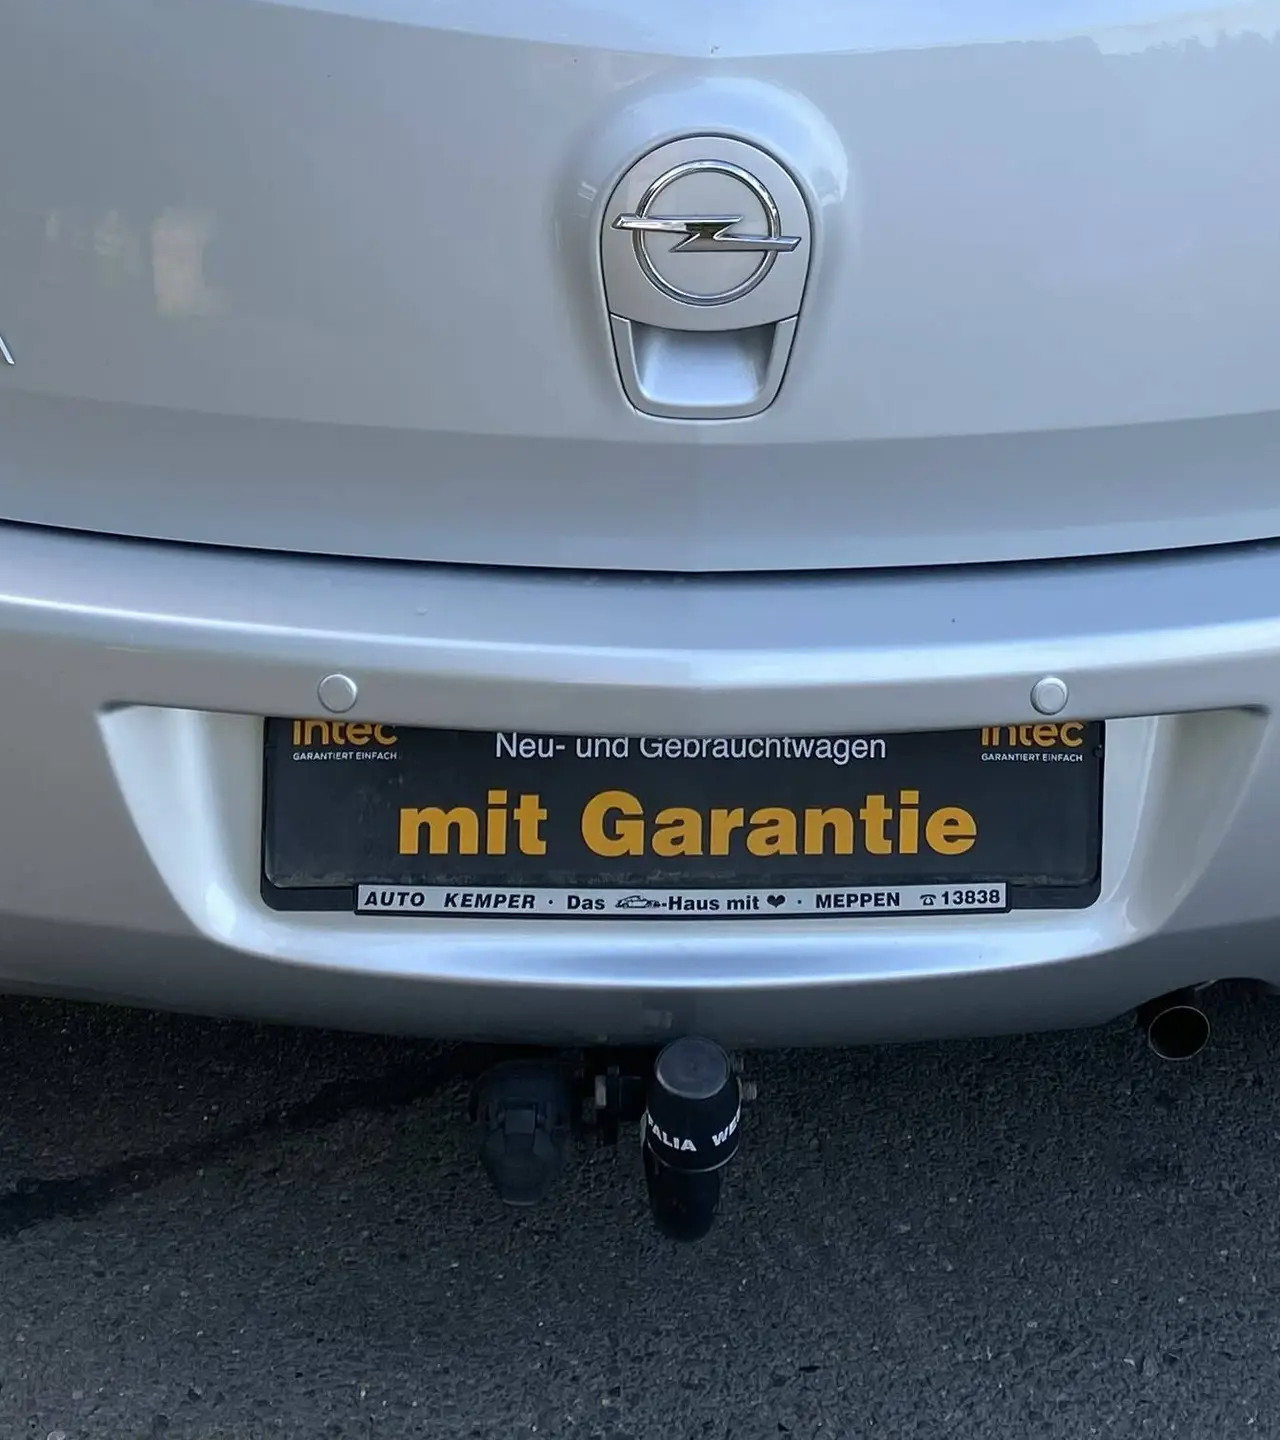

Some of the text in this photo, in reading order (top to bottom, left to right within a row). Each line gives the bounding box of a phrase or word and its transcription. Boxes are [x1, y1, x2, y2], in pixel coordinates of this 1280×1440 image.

[293, 751, 397, 760] GARANTIERT EINFACH
[495, 732, 886, 765] Neu- und Gebrauchtwagen
[981, 753, 1083, 762] GARANTIERT EINFACH
[398, 790, 977, 857] mit Garantie
[365, 892, 425, 907] AUTO
[444, 892, 535, 909] KEMPER
[567, 895, 606, 910] Das
[726, 895, 760, 910] mit
[816, 892, 900, 908] MEPPEN
[941, 889, 1000, 905] 13838
